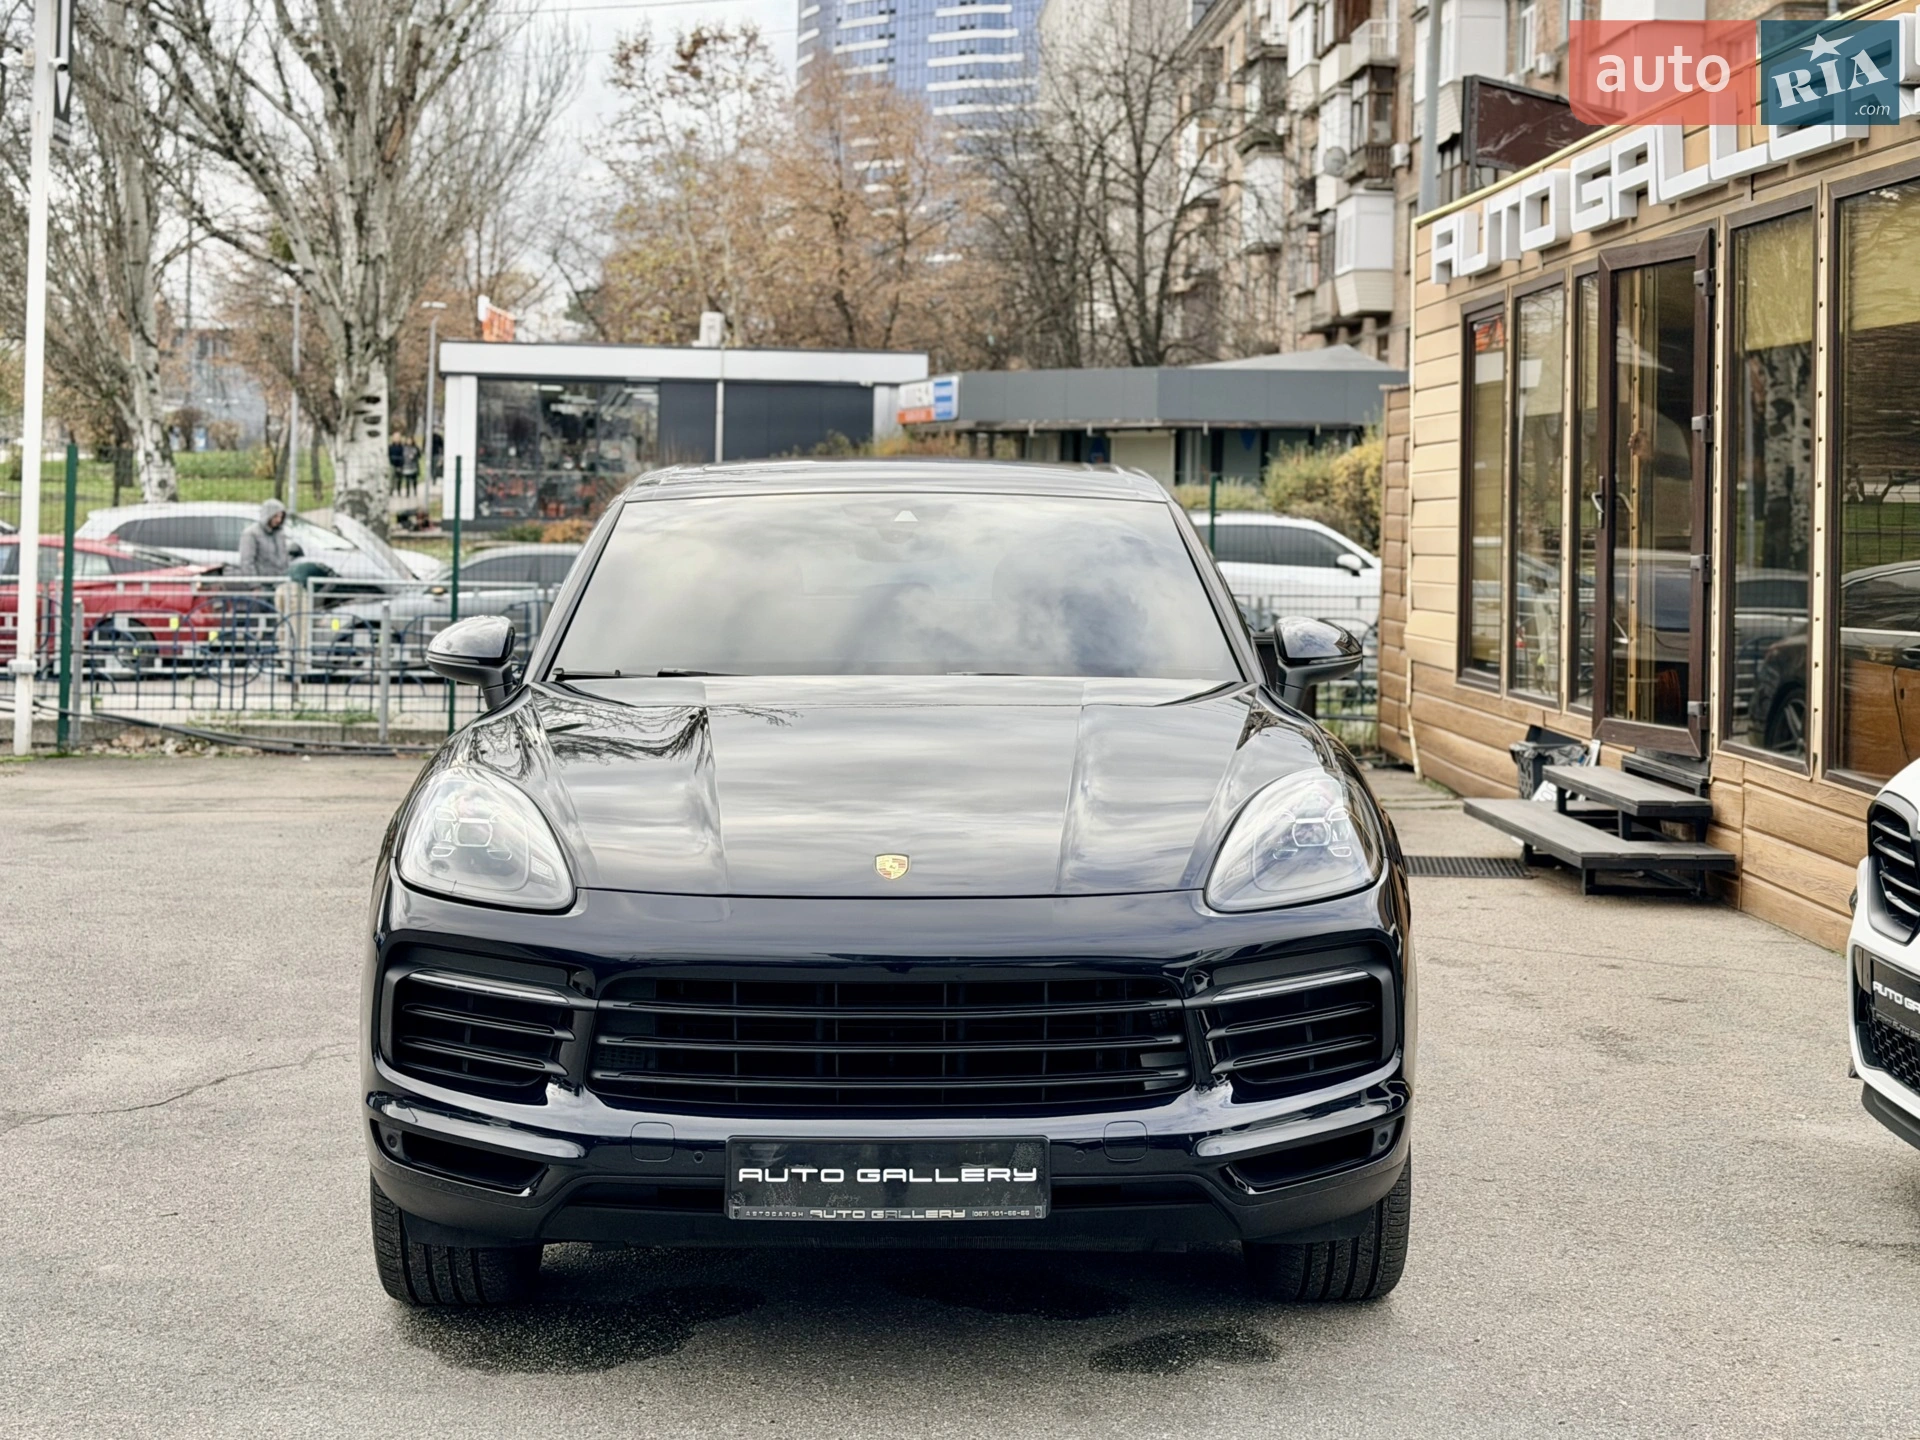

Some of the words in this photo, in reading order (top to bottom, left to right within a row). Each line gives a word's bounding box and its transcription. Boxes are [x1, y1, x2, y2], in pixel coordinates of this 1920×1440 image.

[1431, 168, 1571, 284] AUTO
[1570, 4, 1920, 234] GALLER
[1873, 981, 1903, 1005] AUTO
[739, 1168, 844, 1183] AUTO
[857, 1168, 1036, 1183] GALLERY
[809, 1209, 866, 1219] AUTO
[871, 1209, 966, 1219] GALLERY
